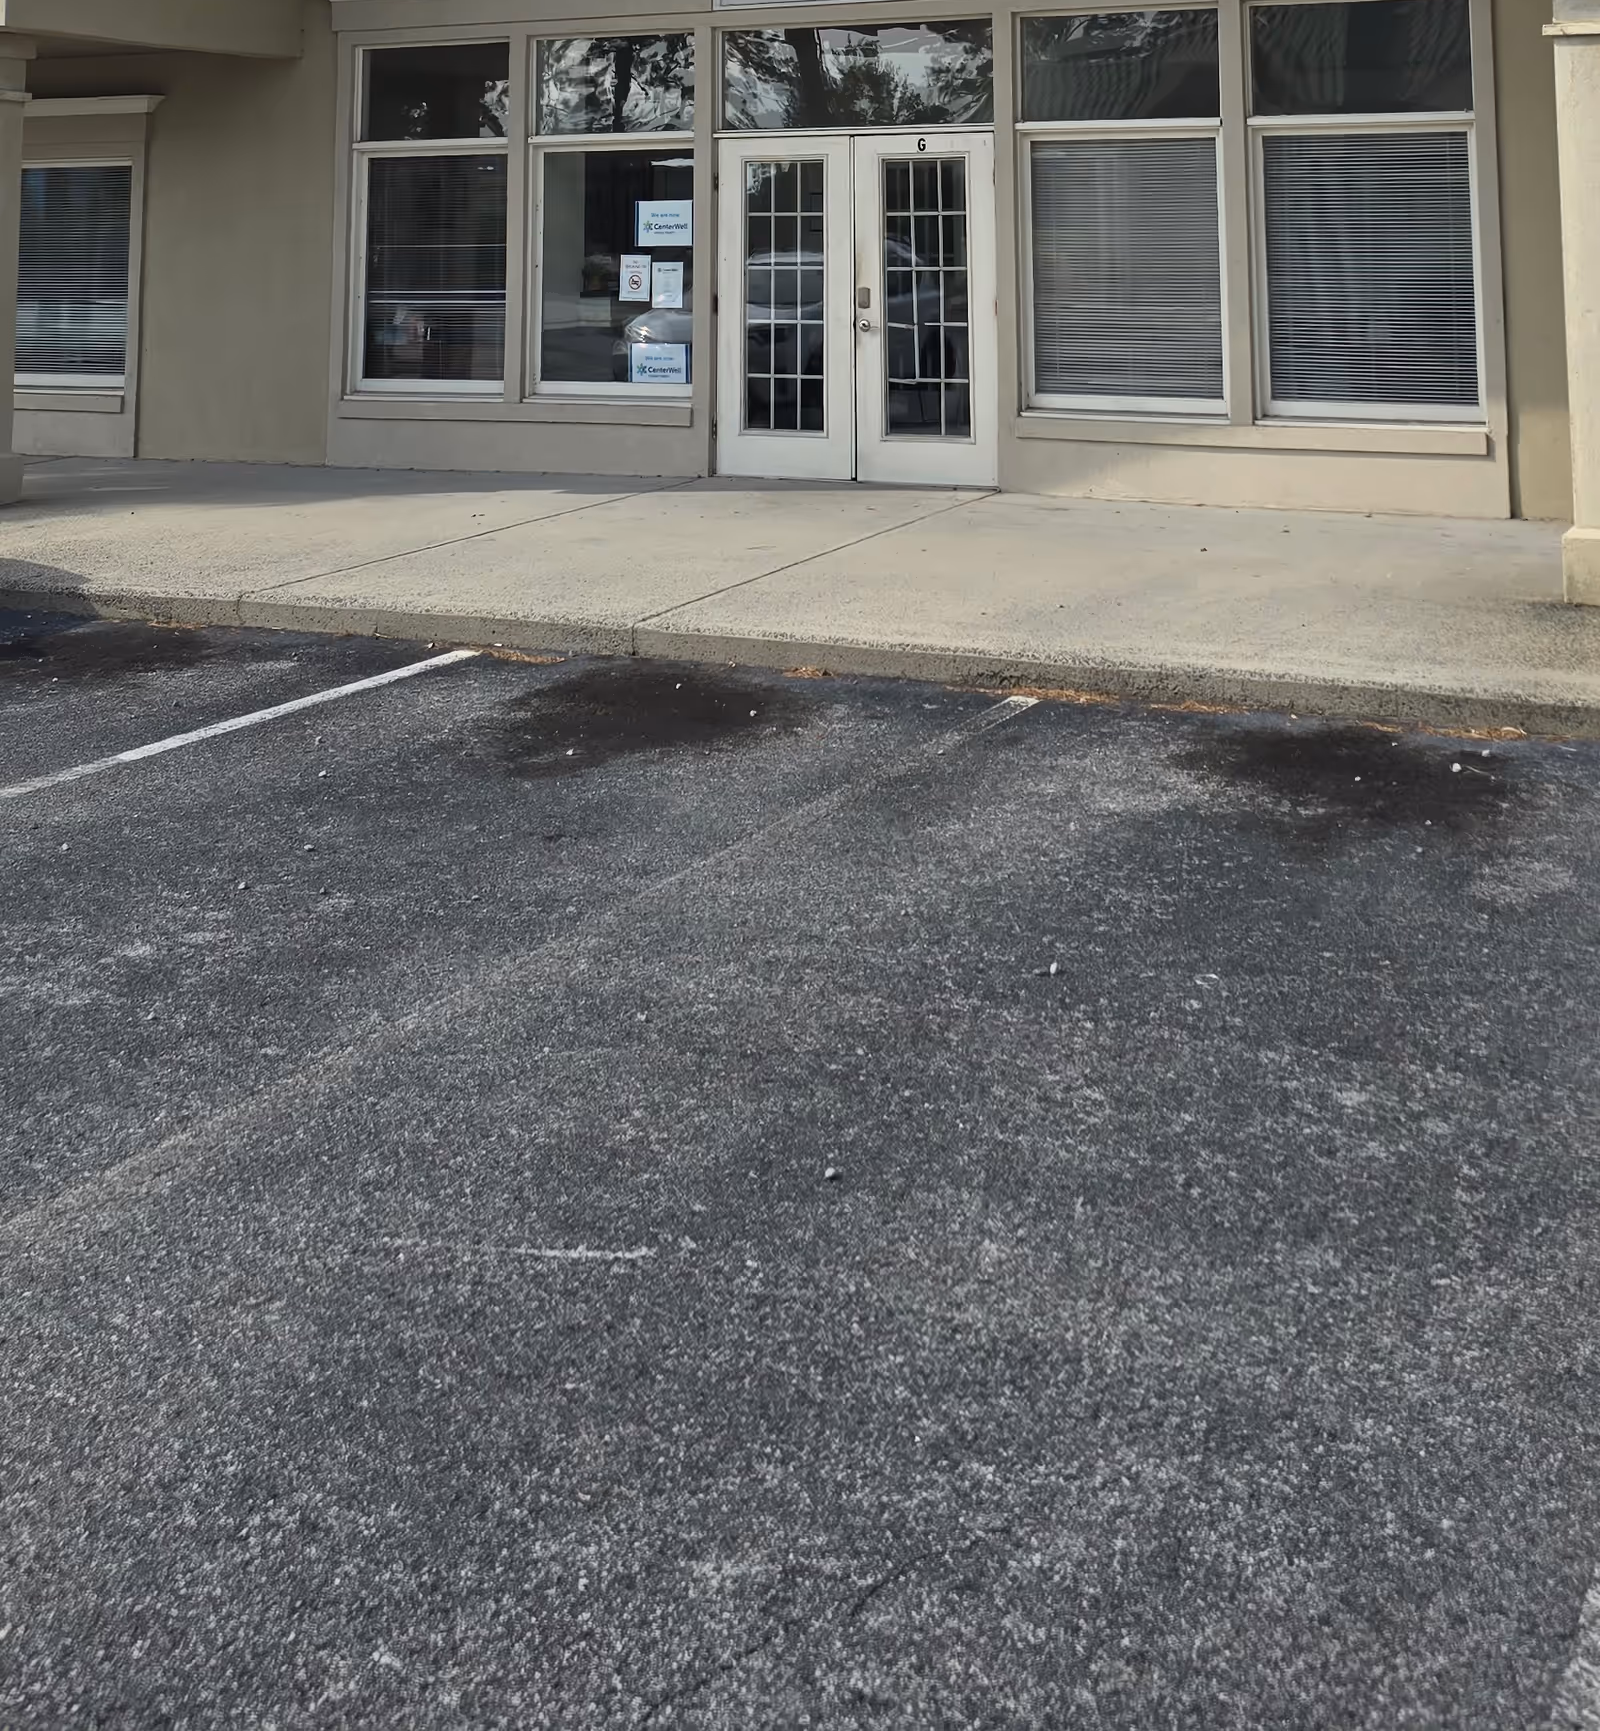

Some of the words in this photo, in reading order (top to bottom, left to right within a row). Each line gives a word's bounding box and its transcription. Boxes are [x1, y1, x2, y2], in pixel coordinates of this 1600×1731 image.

[917, 137, 927, 152] G
[653, 222, 688, 230] CenterWell
[647, 366, 682, 374] CenterWell
